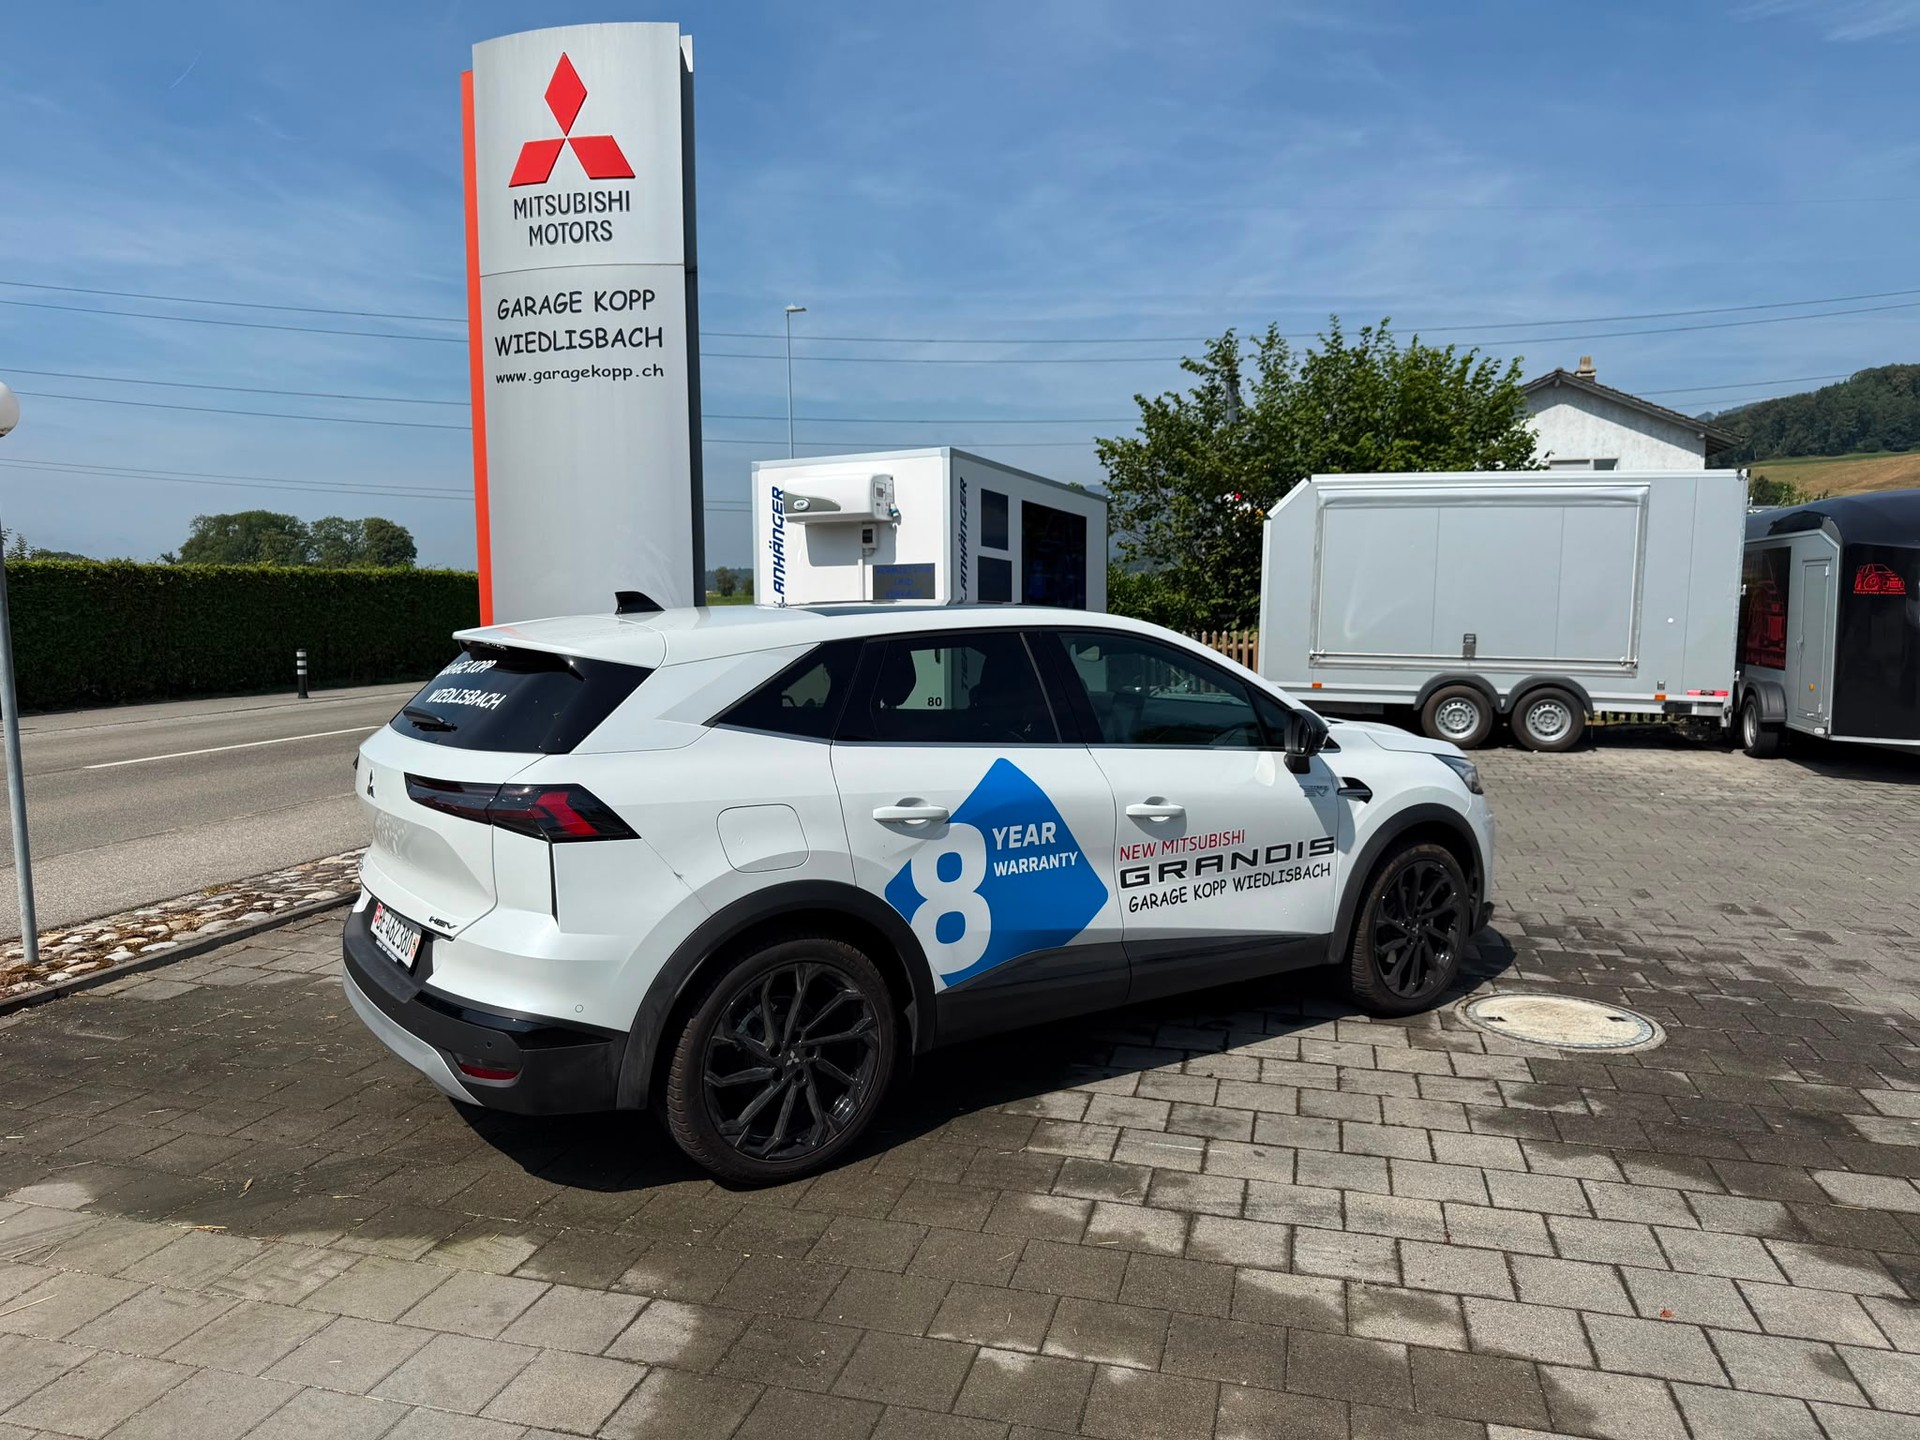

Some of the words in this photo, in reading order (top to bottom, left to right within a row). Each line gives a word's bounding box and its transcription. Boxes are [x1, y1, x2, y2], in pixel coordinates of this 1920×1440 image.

[513, 190, 631, 220] MITSUBISHI
[528, 219, 613, 247] MOTORS
[497, 290, 583, 320] GARAGE
[594, 289, 656, 313] KOPP
[494, 326, 664, 357] WIEDLISBACH
[495, 363, 665, 385] www.garagekopp.ch
[426, 687, 507, 711] WIEDLISBACH
[927, 696, 943, 707] 80
[992, 821, 1057, 851] YEAR
[1119, 841, 1157, 861] NEW
[1161, 829, 1246, 856] MITSUBISHI
[993, 851, 1079, 877] WARRANTY
[1119, 836, 1336, 889] GRANDIS
[910, 822, 992, 976] 8
[1128, 886, 1188, 913] GARAGE
[1193, 879, 1227, 901] KOPP
[1232, 862, 1331, 893] WIEDLISBACH
[428, 916, 458, 930] HEV
